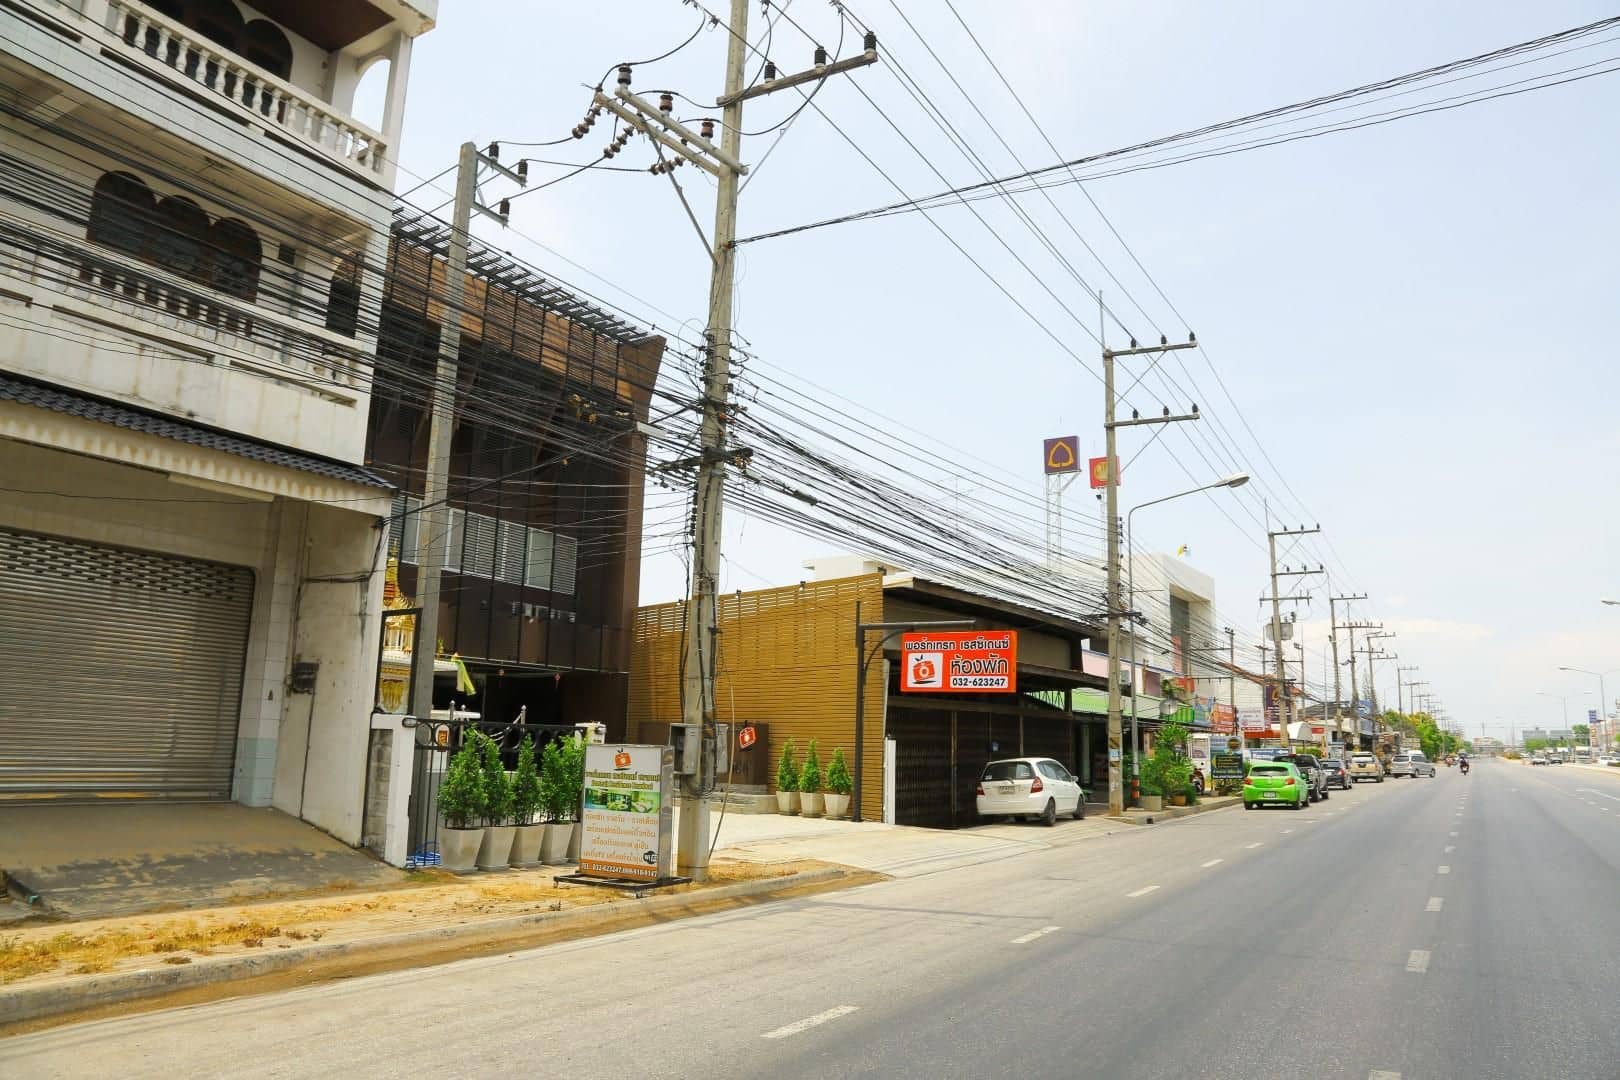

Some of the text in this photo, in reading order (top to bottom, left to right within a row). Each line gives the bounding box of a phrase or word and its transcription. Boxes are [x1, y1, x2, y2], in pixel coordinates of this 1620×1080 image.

[951, 654, 1008, 675] ห้องพัก
[952, 678, 1006, 687] 032-623247
